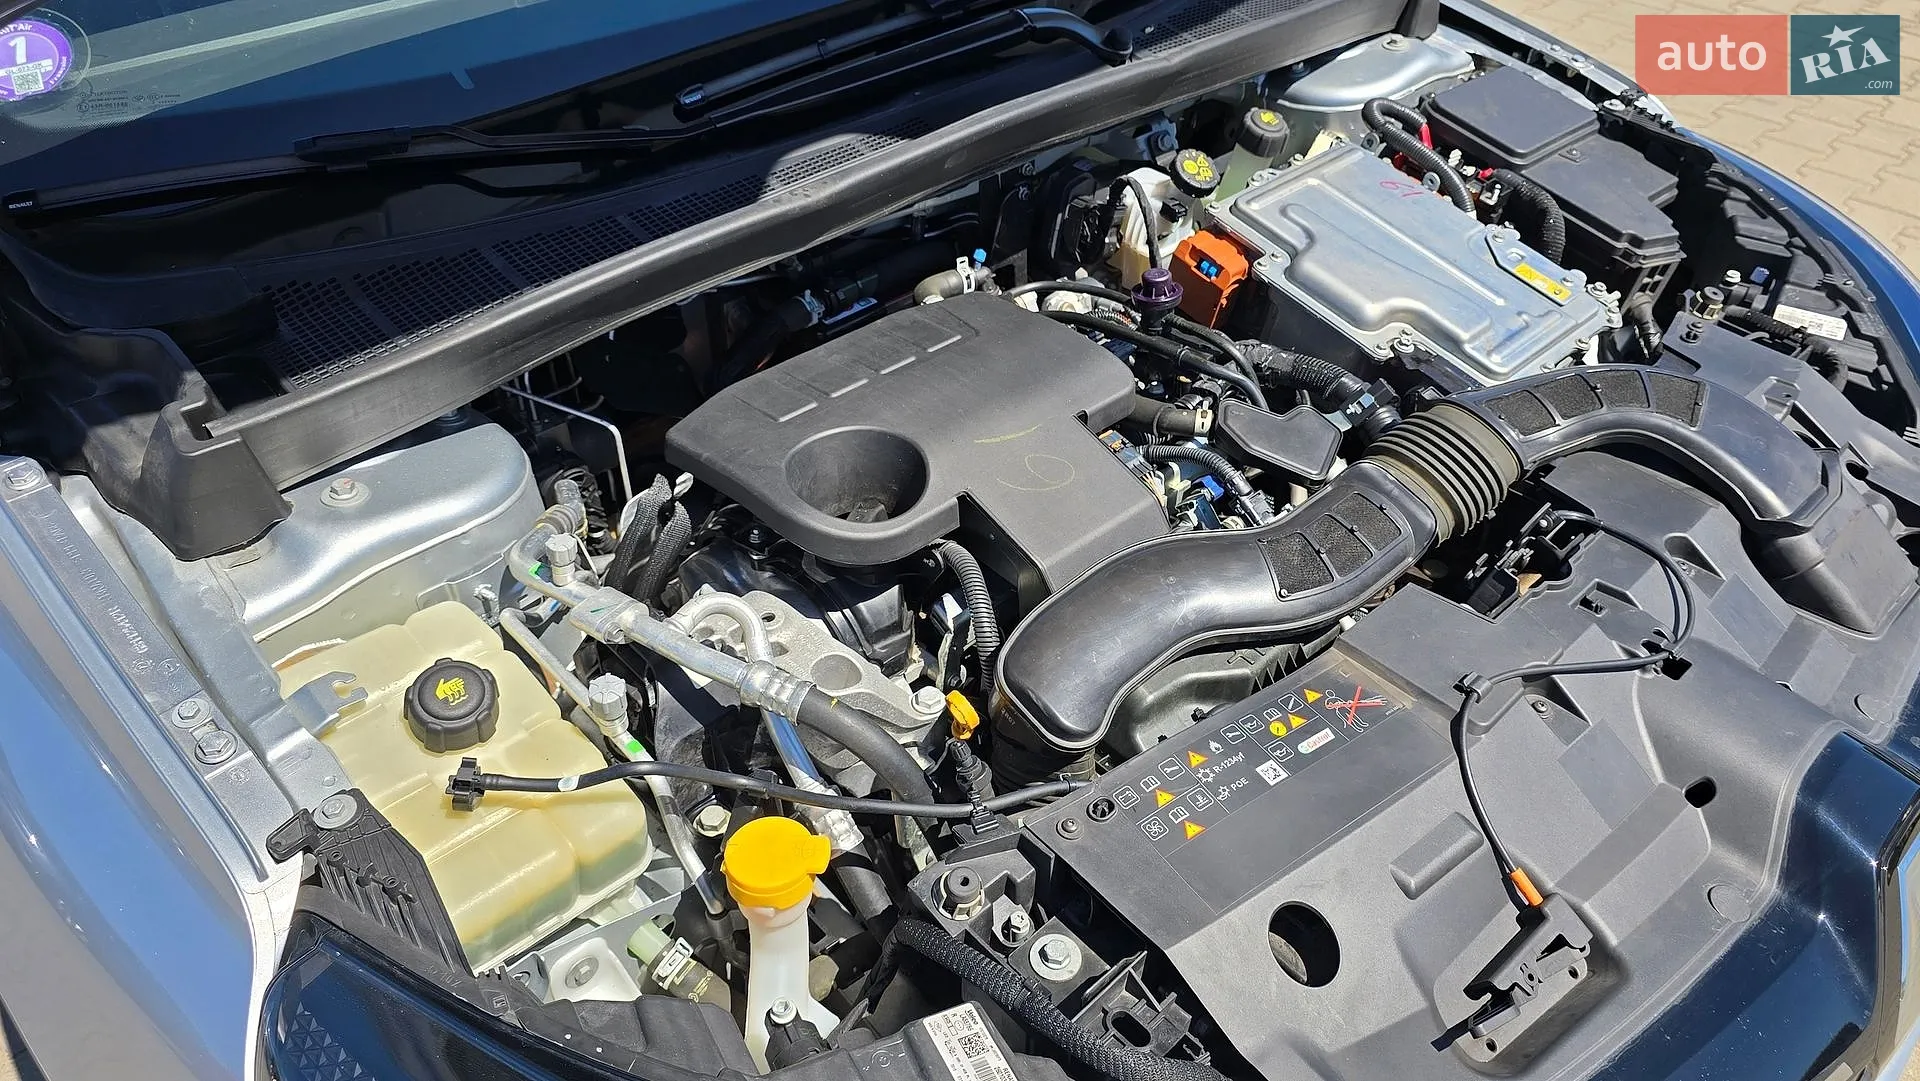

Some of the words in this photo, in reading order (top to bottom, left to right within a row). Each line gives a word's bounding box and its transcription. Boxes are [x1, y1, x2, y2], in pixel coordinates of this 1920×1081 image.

[8, 36, 27, 65] 1
[1212, 751, 1245, 773] R-1234yf
[1230, 777, 1249, 791] POE
